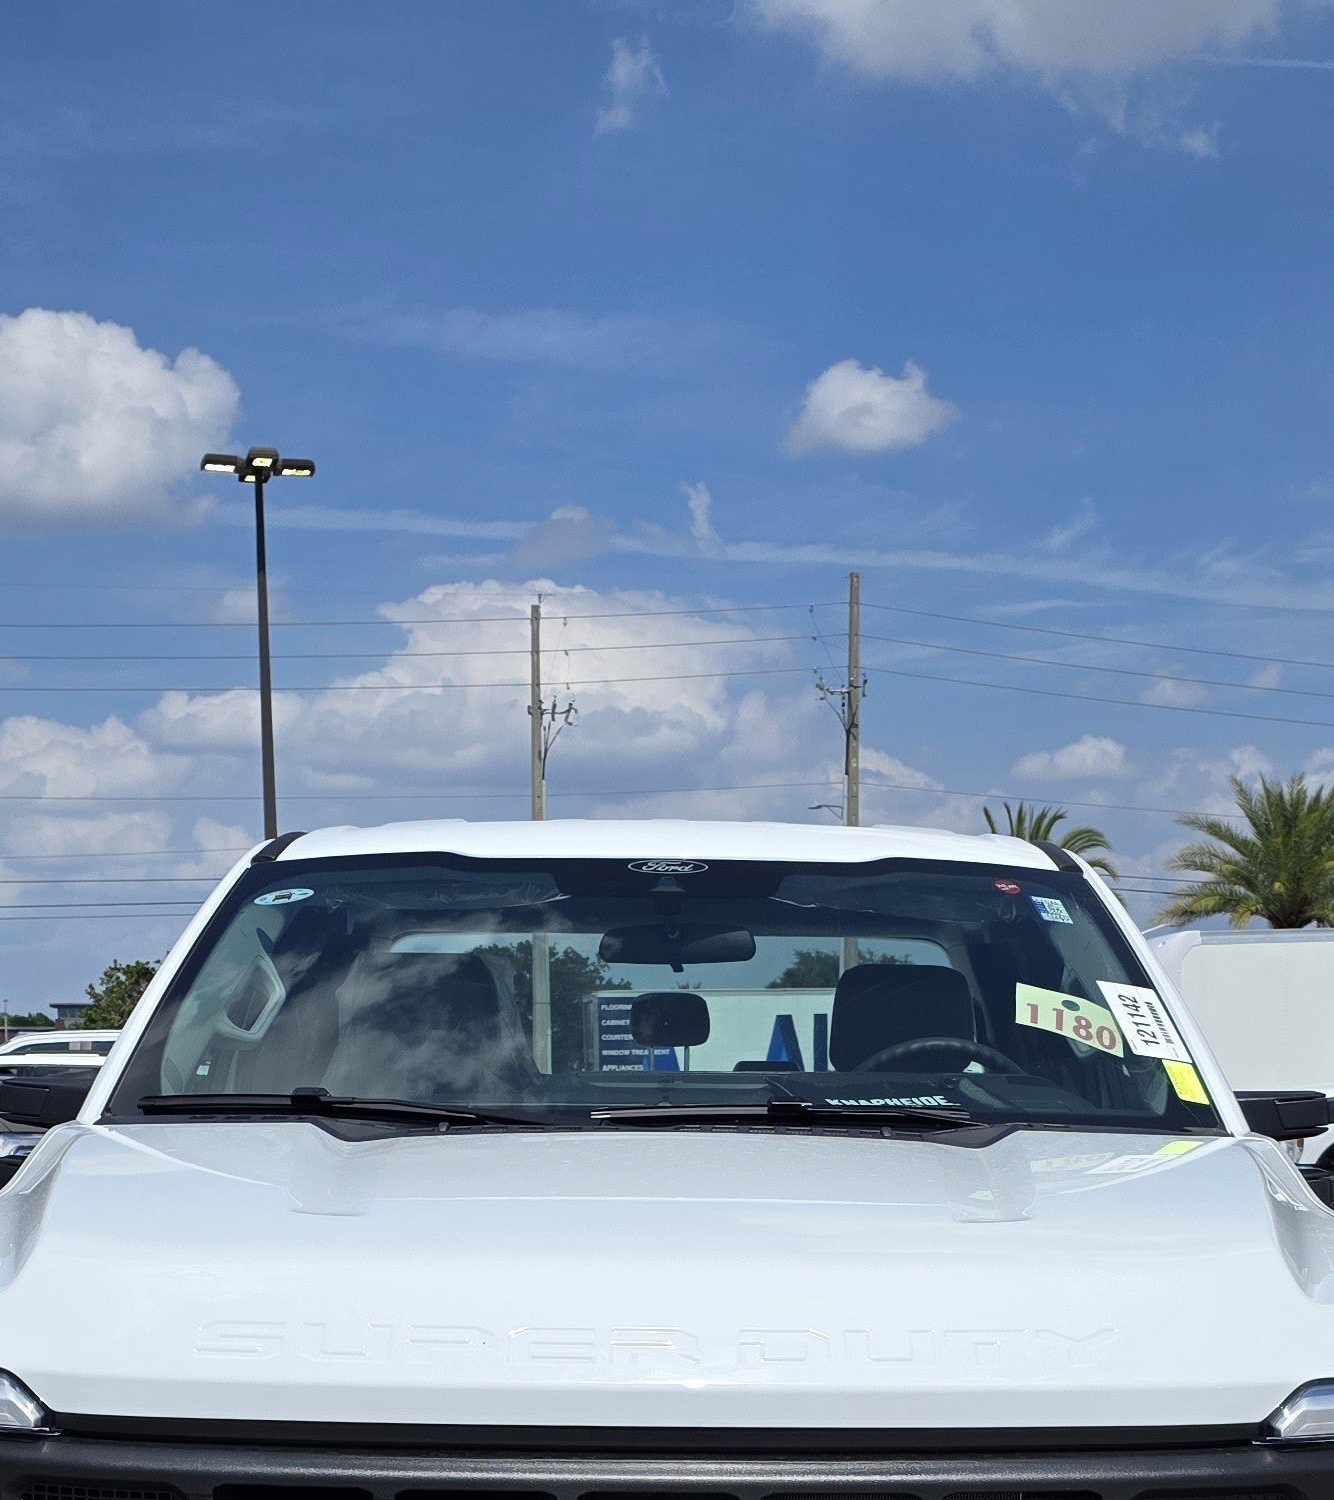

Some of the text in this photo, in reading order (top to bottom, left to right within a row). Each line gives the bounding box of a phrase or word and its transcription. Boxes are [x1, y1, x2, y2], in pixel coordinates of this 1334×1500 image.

[641, 860, 694, 873] Ford
[1026, 1002, 1117, 1050] 1180
[1117, 994, 1160, 1046] 121142
[191, 1319, 1121, 1367] SUPER DUTY
